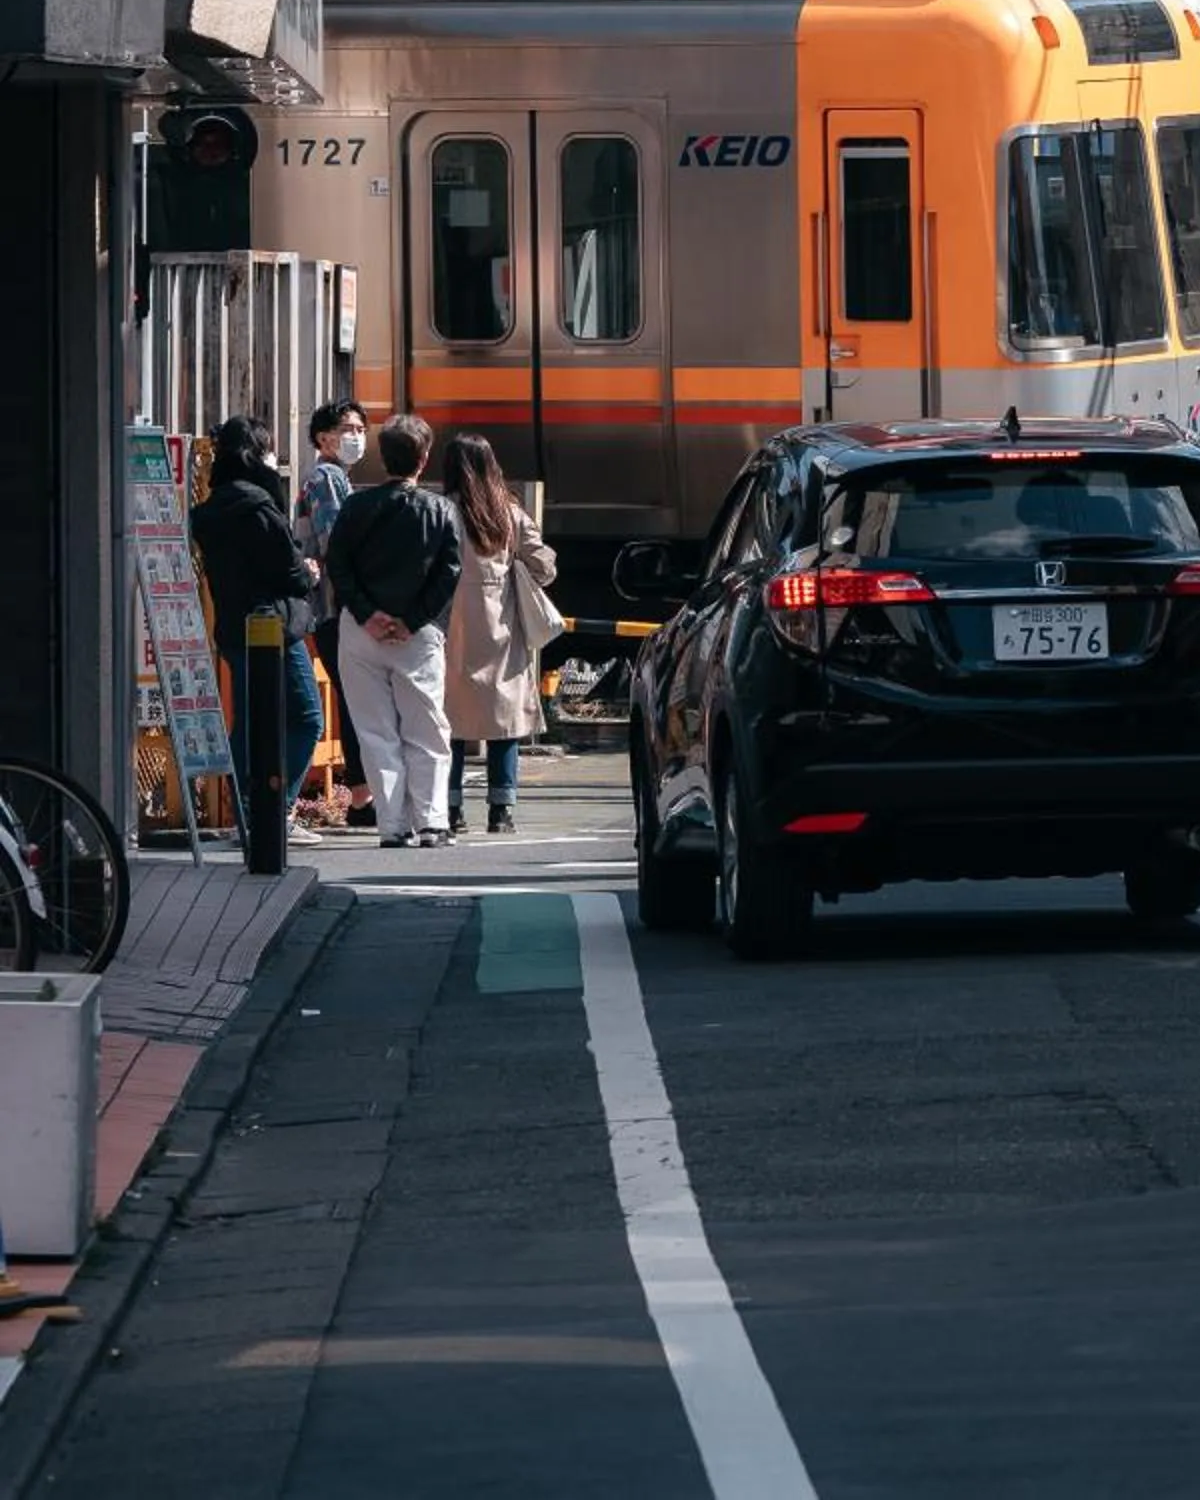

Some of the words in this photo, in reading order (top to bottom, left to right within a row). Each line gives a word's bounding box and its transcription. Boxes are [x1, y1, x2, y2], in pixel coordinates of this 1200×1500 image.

[275, 138, 367, 167] 1727
[678, 134, 792, 167] KEIO
[1055, 606, 1083, 622] 300
[1019, 627, 1102, 656] 75-76
